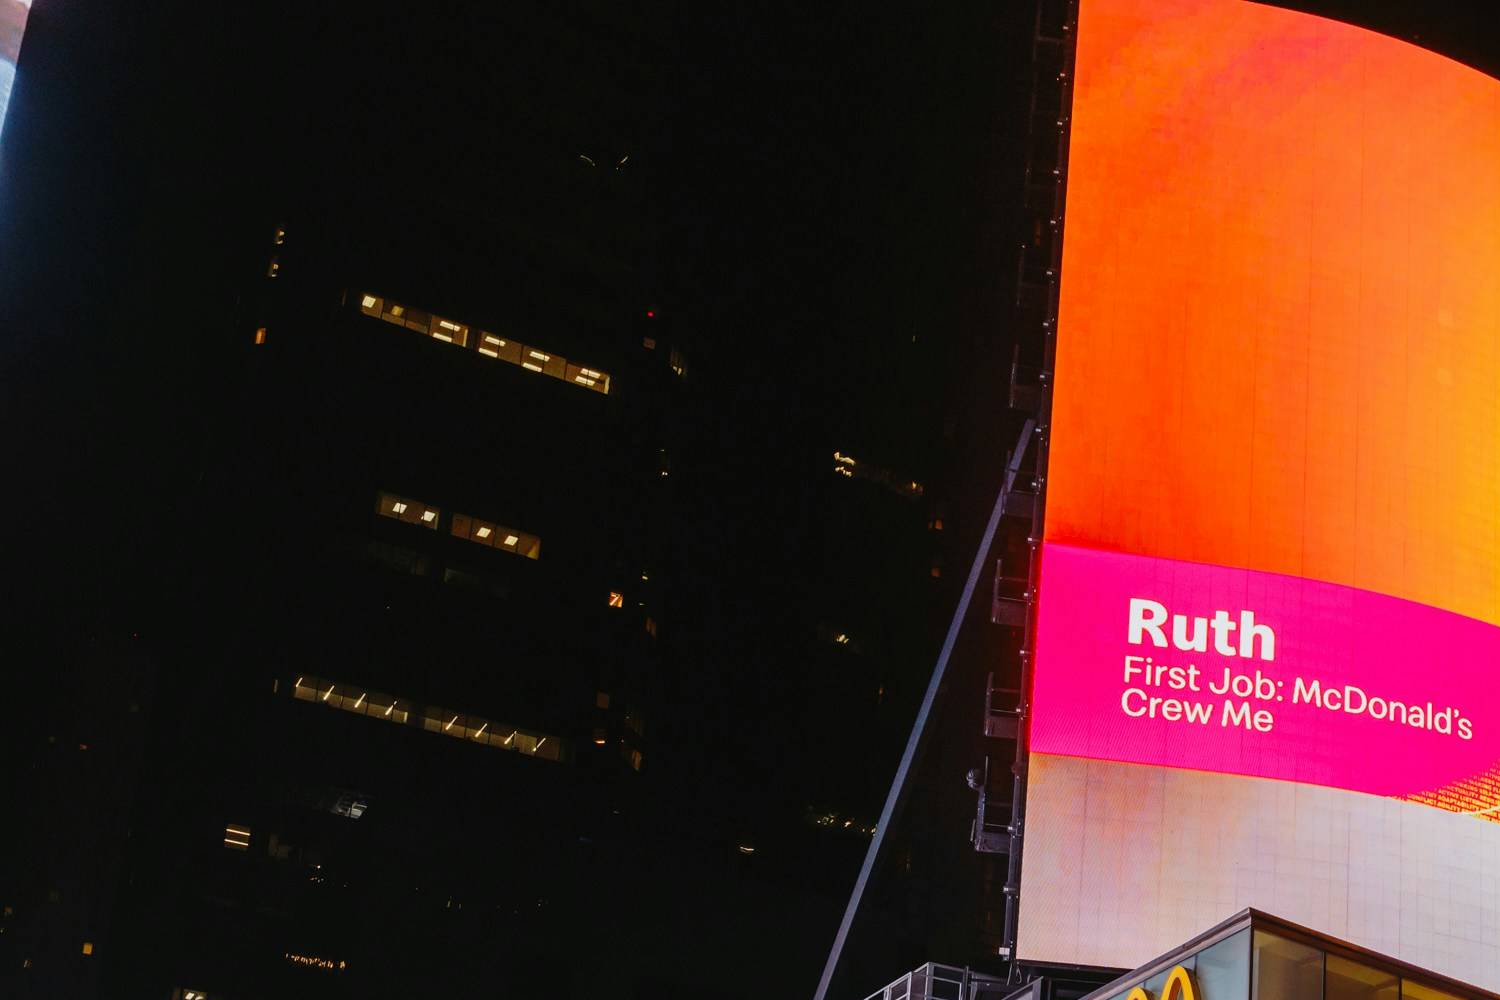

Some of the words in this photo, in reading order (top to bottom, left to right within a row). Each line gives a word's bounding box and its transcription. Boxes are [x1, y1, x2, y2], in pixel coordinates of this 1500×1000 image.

[1127, 597, 1276, 661] Ruth
[1121, 687, 1213, 726] Crew
[1221, 700, 1275, 732] Me
[1124, 655, 1200, 692] First
[1209, 666, 1284, 701] Job:
[1293, 677, 1473, 740] McDonald's
